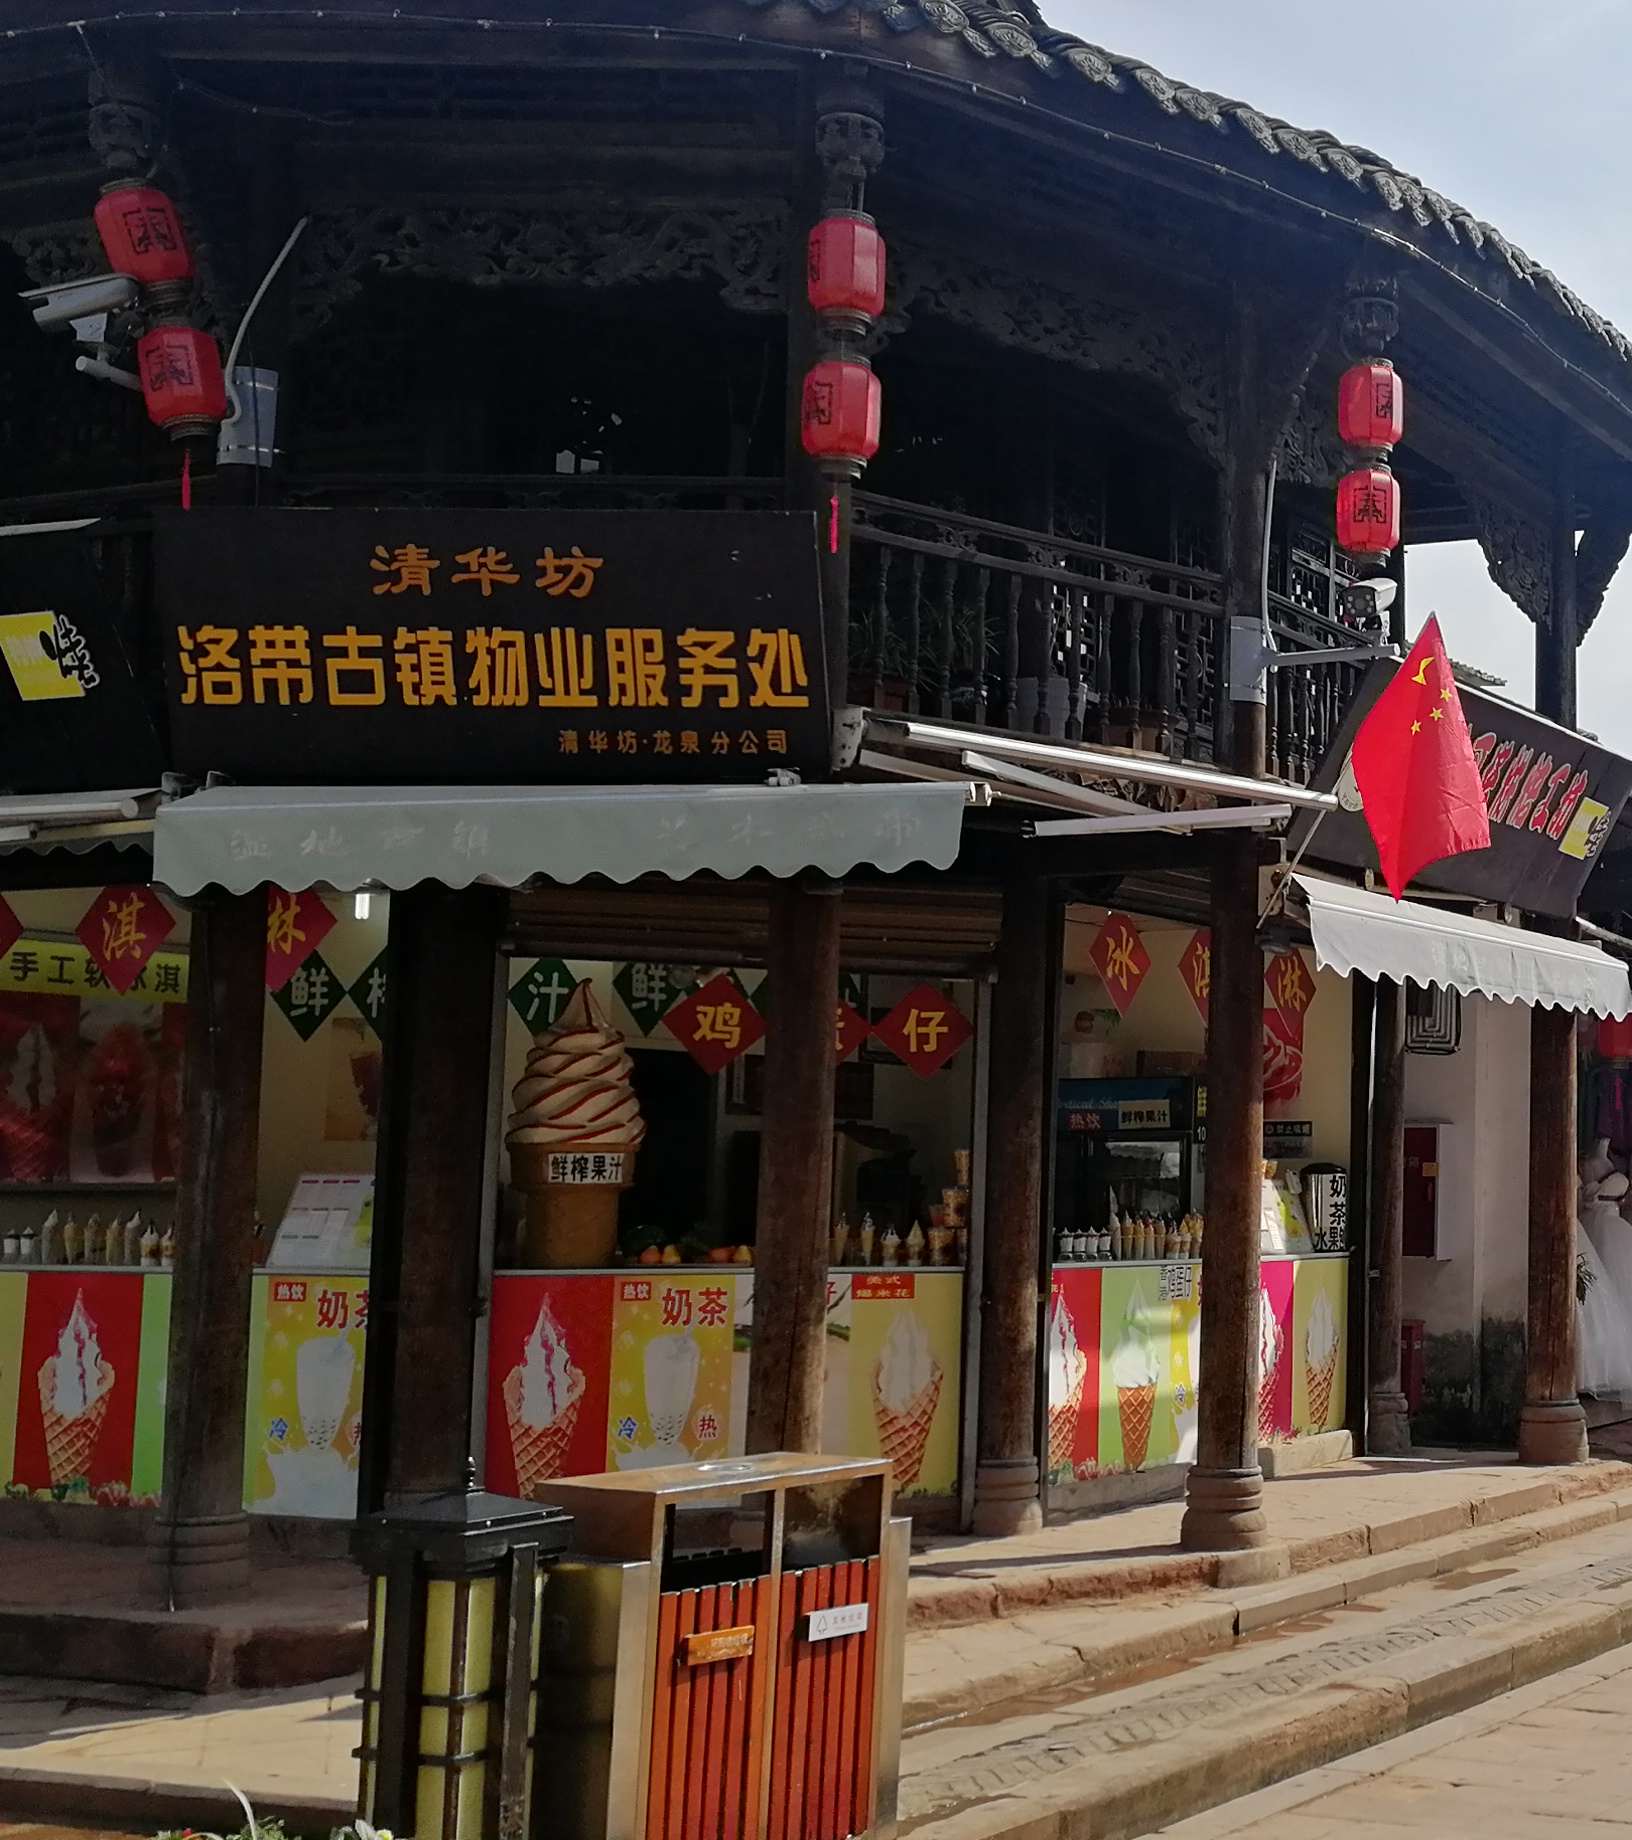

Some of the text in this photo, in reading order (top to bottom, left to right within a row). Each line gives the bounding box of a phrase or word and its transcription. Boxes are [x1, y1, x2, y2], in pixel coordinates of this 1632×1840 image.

[369, 544, 604, 598] 清华坊
[178, 624, 811, 708] 洛带古镇物业服务处
[558, 729, 788, 755] 清华坊·龙泉分公司
[103, 891, 147, 961] 淇
[1106, 925, 1140, 992] 冰
[527, 971, 570, 1024] 汁
[692, 1002, 742, 1050] 鸡
[903, 1008, 948, 1053] 仔
[1069, 1112, 1102, 1130] 热饮
[551, 1155, 621, 1182] 鲜榨果汁
[1329, 1175, 1347, 1226] 奶茶
[276, 1283, 305, 1300] 热饮
[622, 1283, 650, 1300] 热饮
[661, 1287, 728, 1327] 奶茶
[269, 1416, 289, 1441] 冷
[618, 1416, 638, 1441] 冷
[699, 1415, 718, 1439] 热
